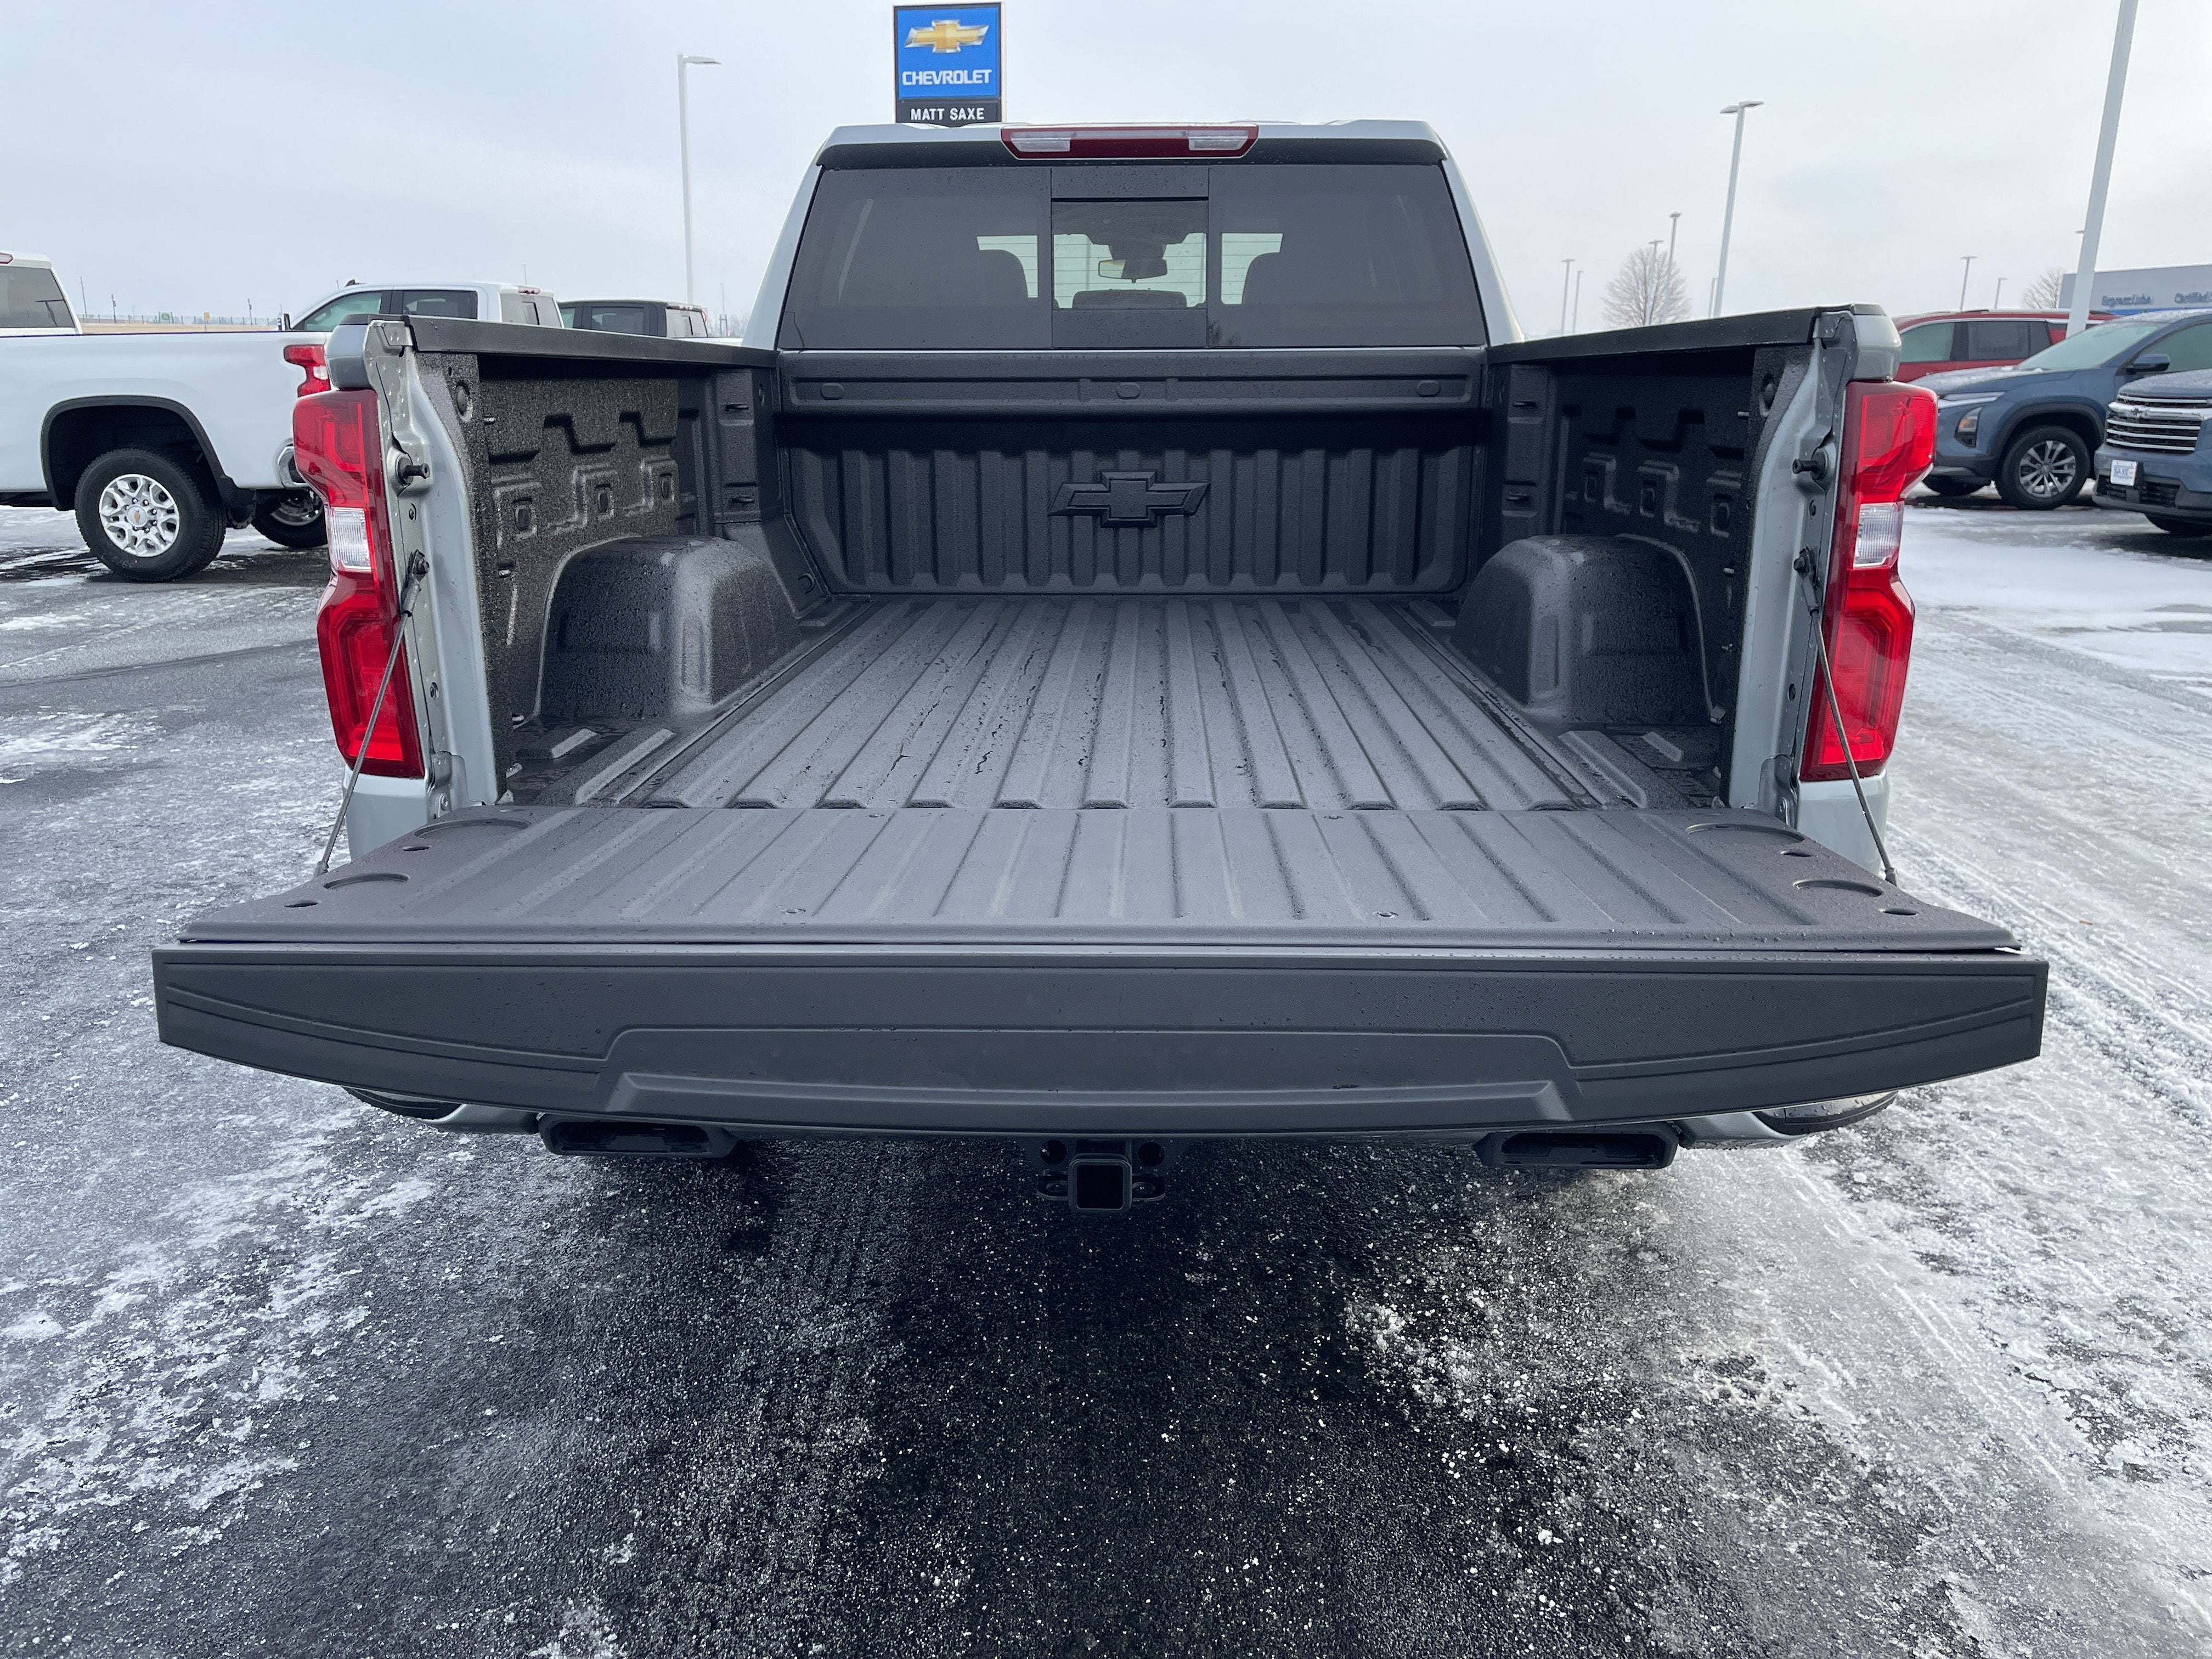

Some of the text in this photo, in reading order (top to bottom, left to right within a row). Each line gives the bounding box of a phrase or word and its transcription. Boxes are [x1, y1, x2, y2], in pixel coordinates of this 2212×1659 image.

[902, 70, 992, 85] CHEVROLET
[910, 108, 985, 121] MATT SAXE
